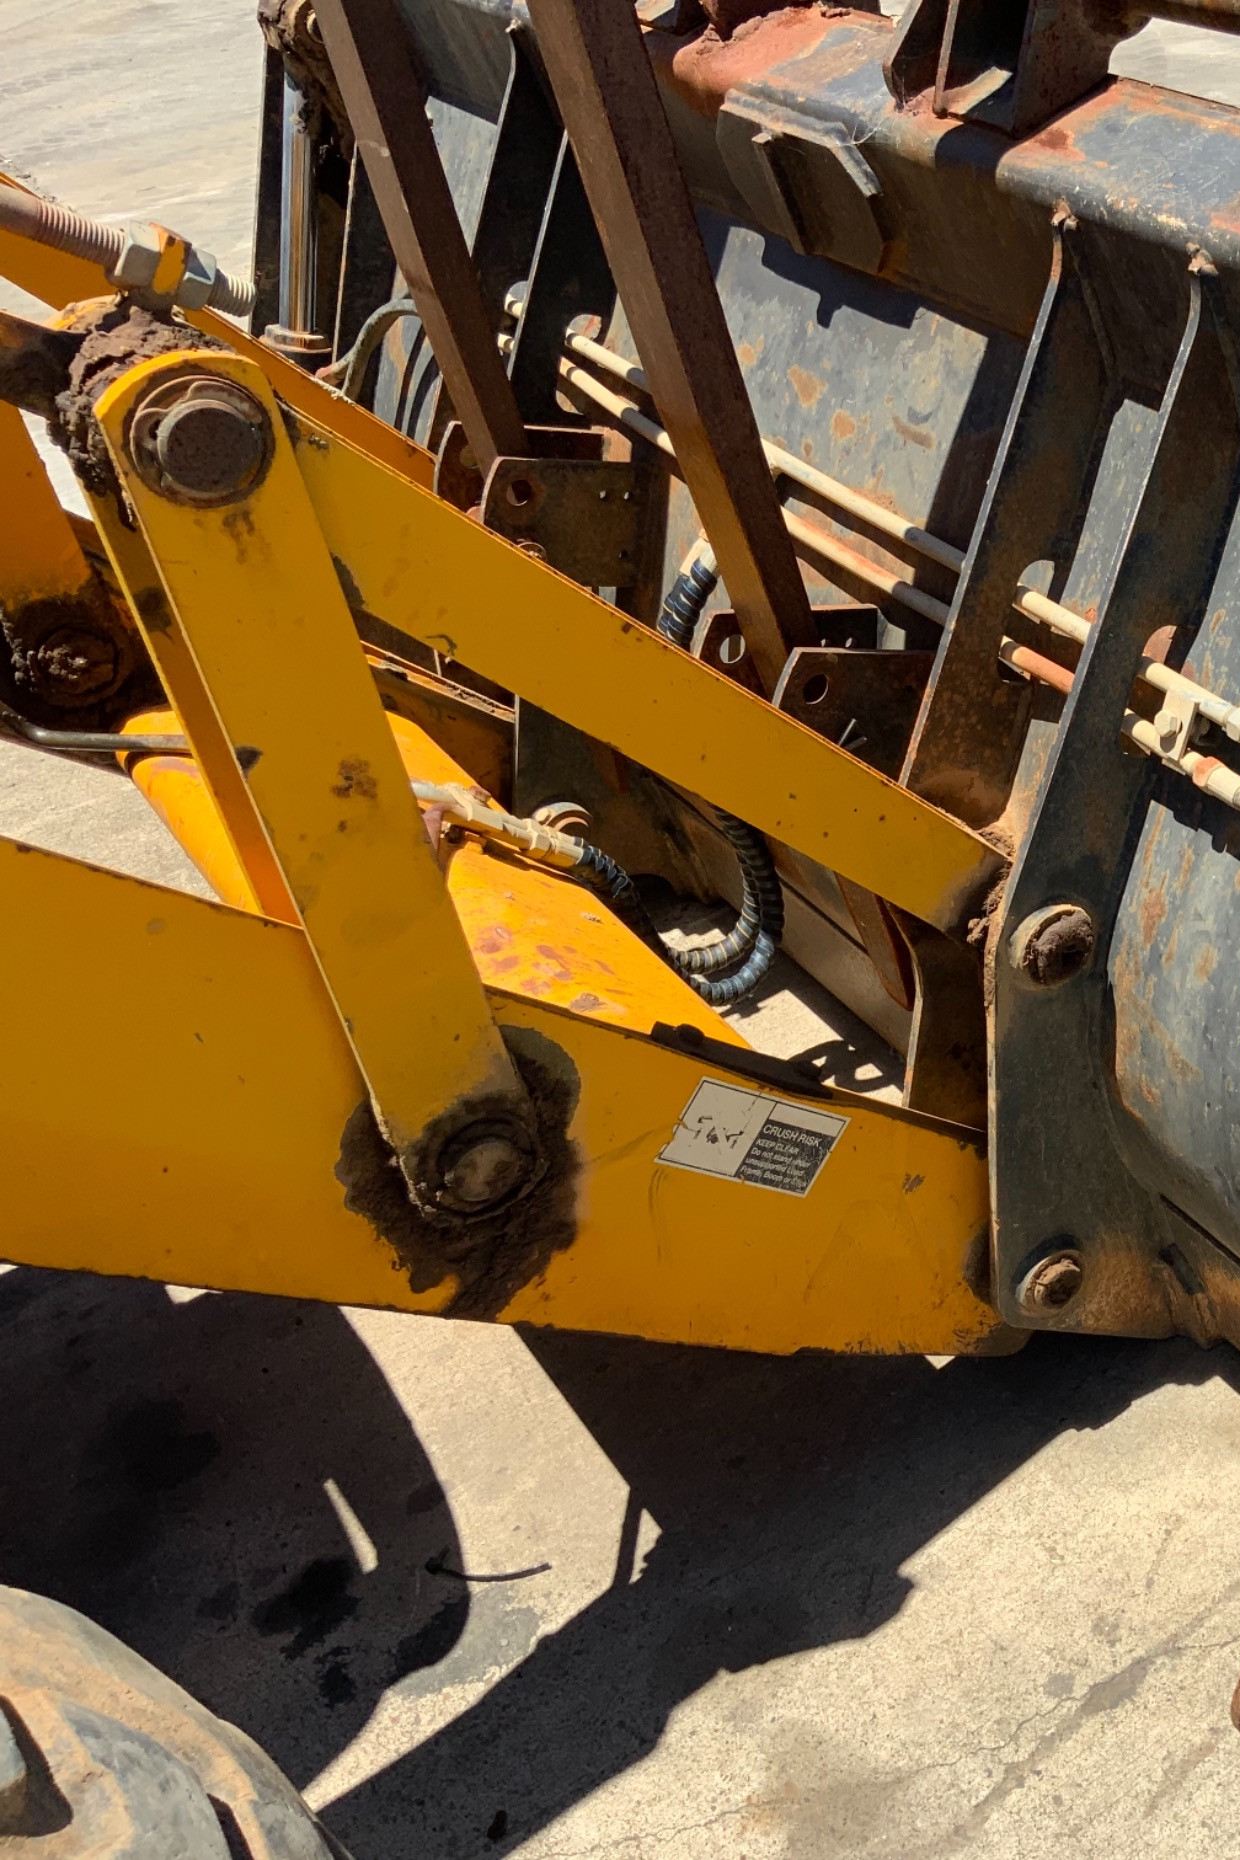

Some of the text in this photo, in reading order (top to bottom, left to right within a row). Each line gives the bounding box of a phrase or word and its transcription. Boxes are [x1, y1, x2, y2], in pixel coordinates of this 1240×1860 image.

[763, 1124, 822, 1147] CRUSH RISK
[751, 1147, 761, 1156] Do
[762, 1151, 774, 1160] not
[756, 1138, 800, 1155] KEEP CLEAR
